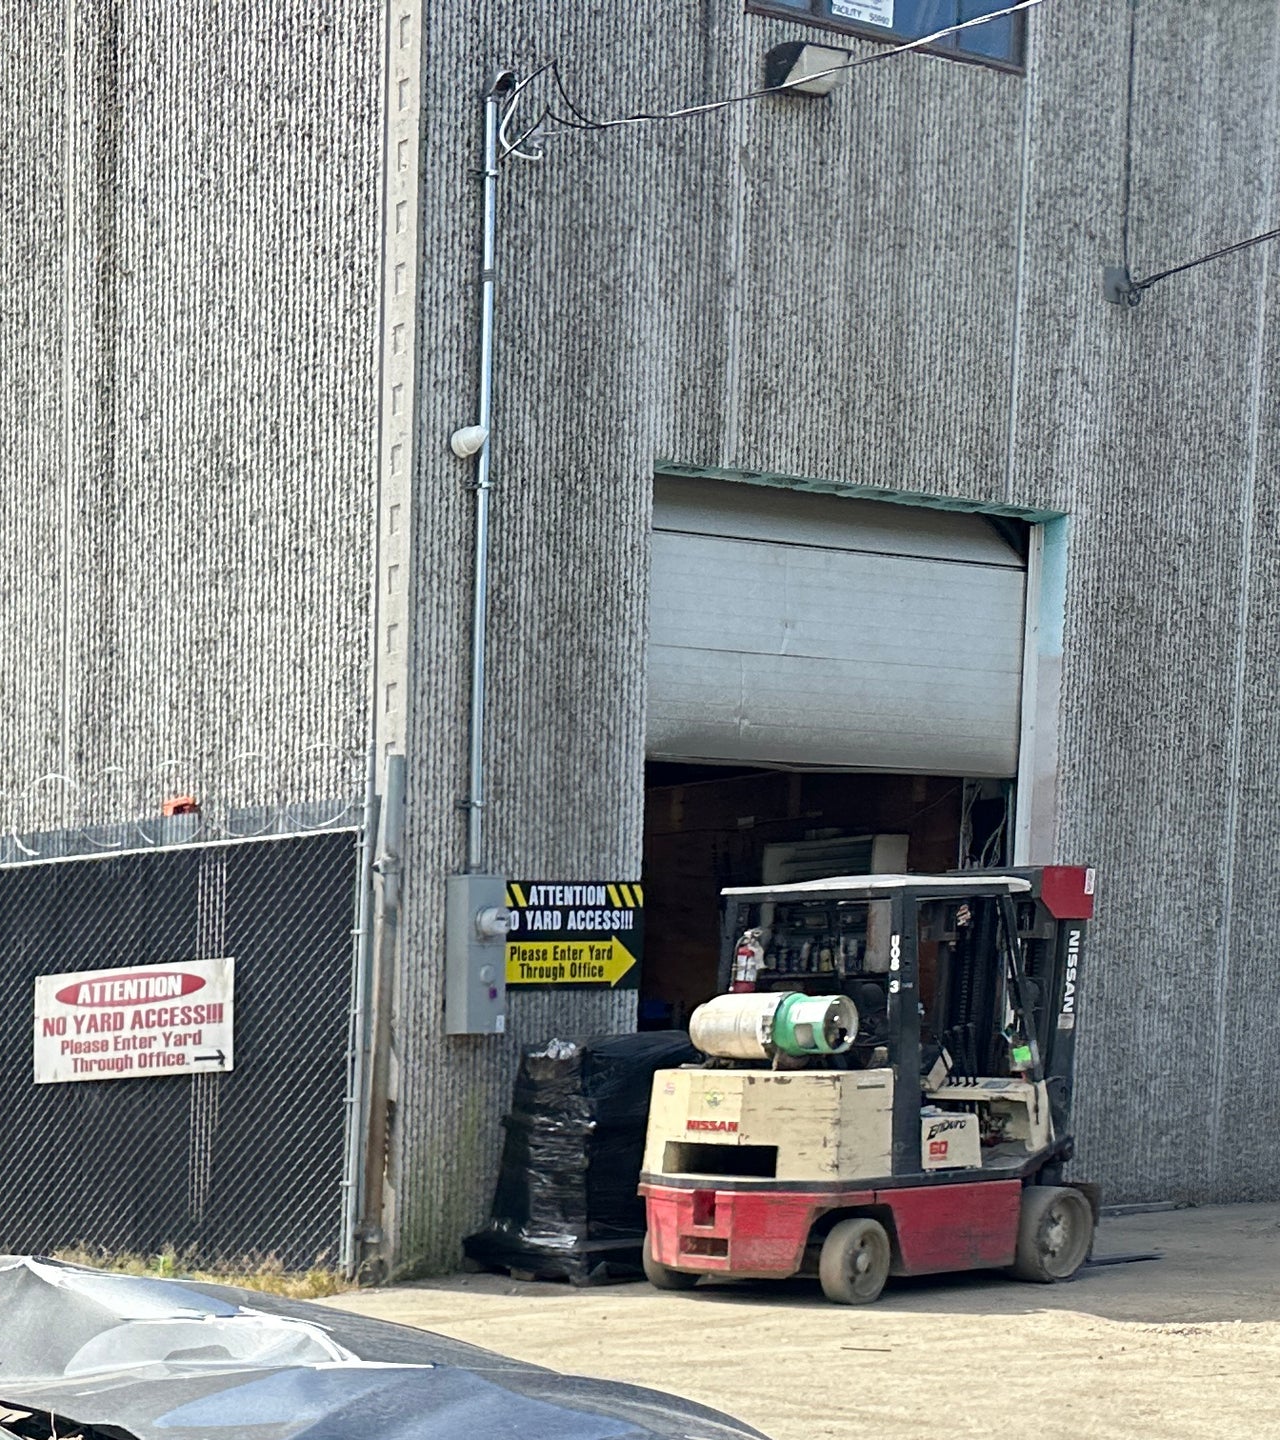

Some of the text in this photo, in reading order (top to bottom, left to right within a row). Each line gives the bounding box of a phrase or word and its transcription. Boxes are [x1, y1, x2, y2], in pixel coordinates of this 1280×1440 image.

[528, 885, 606, 906] ATTENTION
[525, 910, 561, 930] YARD
[567, 910, 633, 930] ACCESS!!!
[510, 945, 613, 961] Please Enter Yard
[519, 962, 604, 980] Through Office
[1062, 930, 1081, 1013] NISSAN
[77, 975, 182, 1005] ATTENTION
[43, 1003, 224, 1037] NO YARD ACCESS!!!
[61, 1030, 202, 1056] Please Enter Yard
[72, 1057, 133, 1074] Through
[686, 1120, 739, 1133] NISSAN
